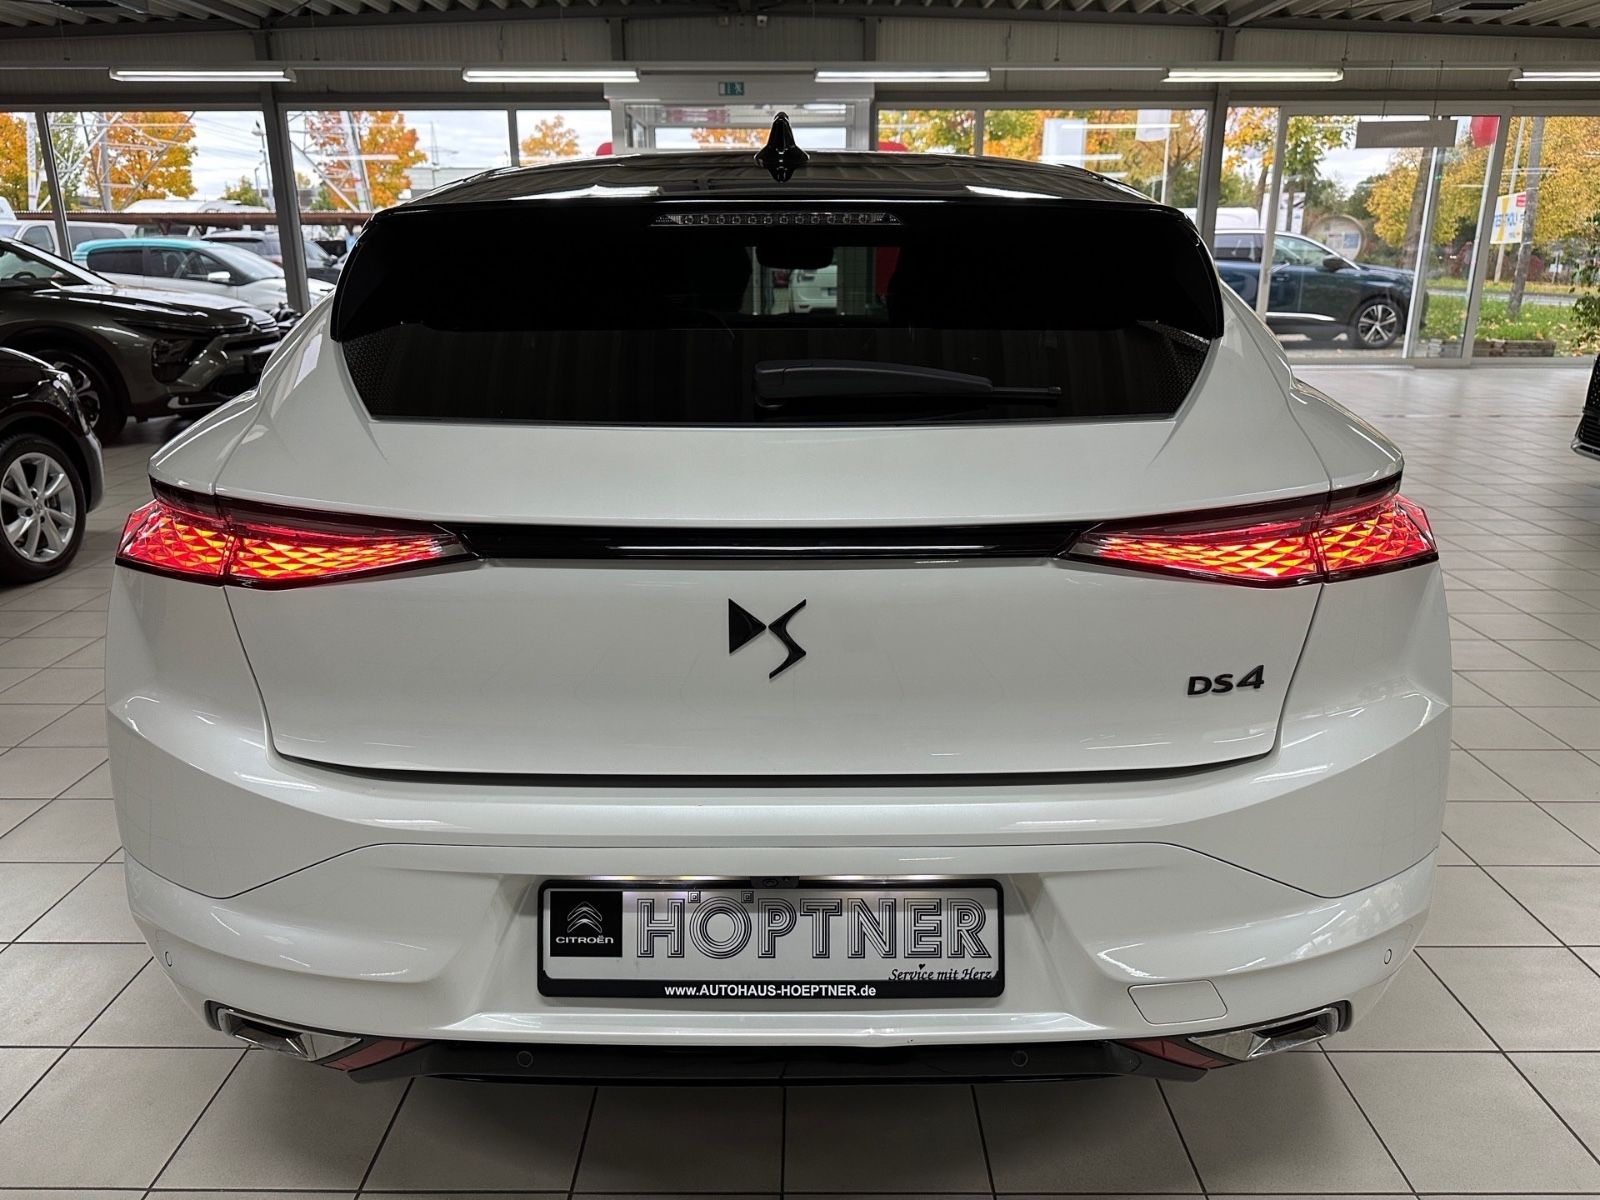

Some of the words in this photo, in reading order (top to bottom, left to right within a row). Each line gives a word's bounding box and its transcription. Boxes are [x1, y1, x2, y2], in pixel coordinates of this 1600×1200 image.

[636, 890, 993, 959] HÖPTNER
[888, 967, 934, 981] Service
[936, 968, 960, 981] mit
[961, 966, 993, 981] Herz
[664, 983, 877, 997] www.AUTOHAUS-HOEPTNER.de
